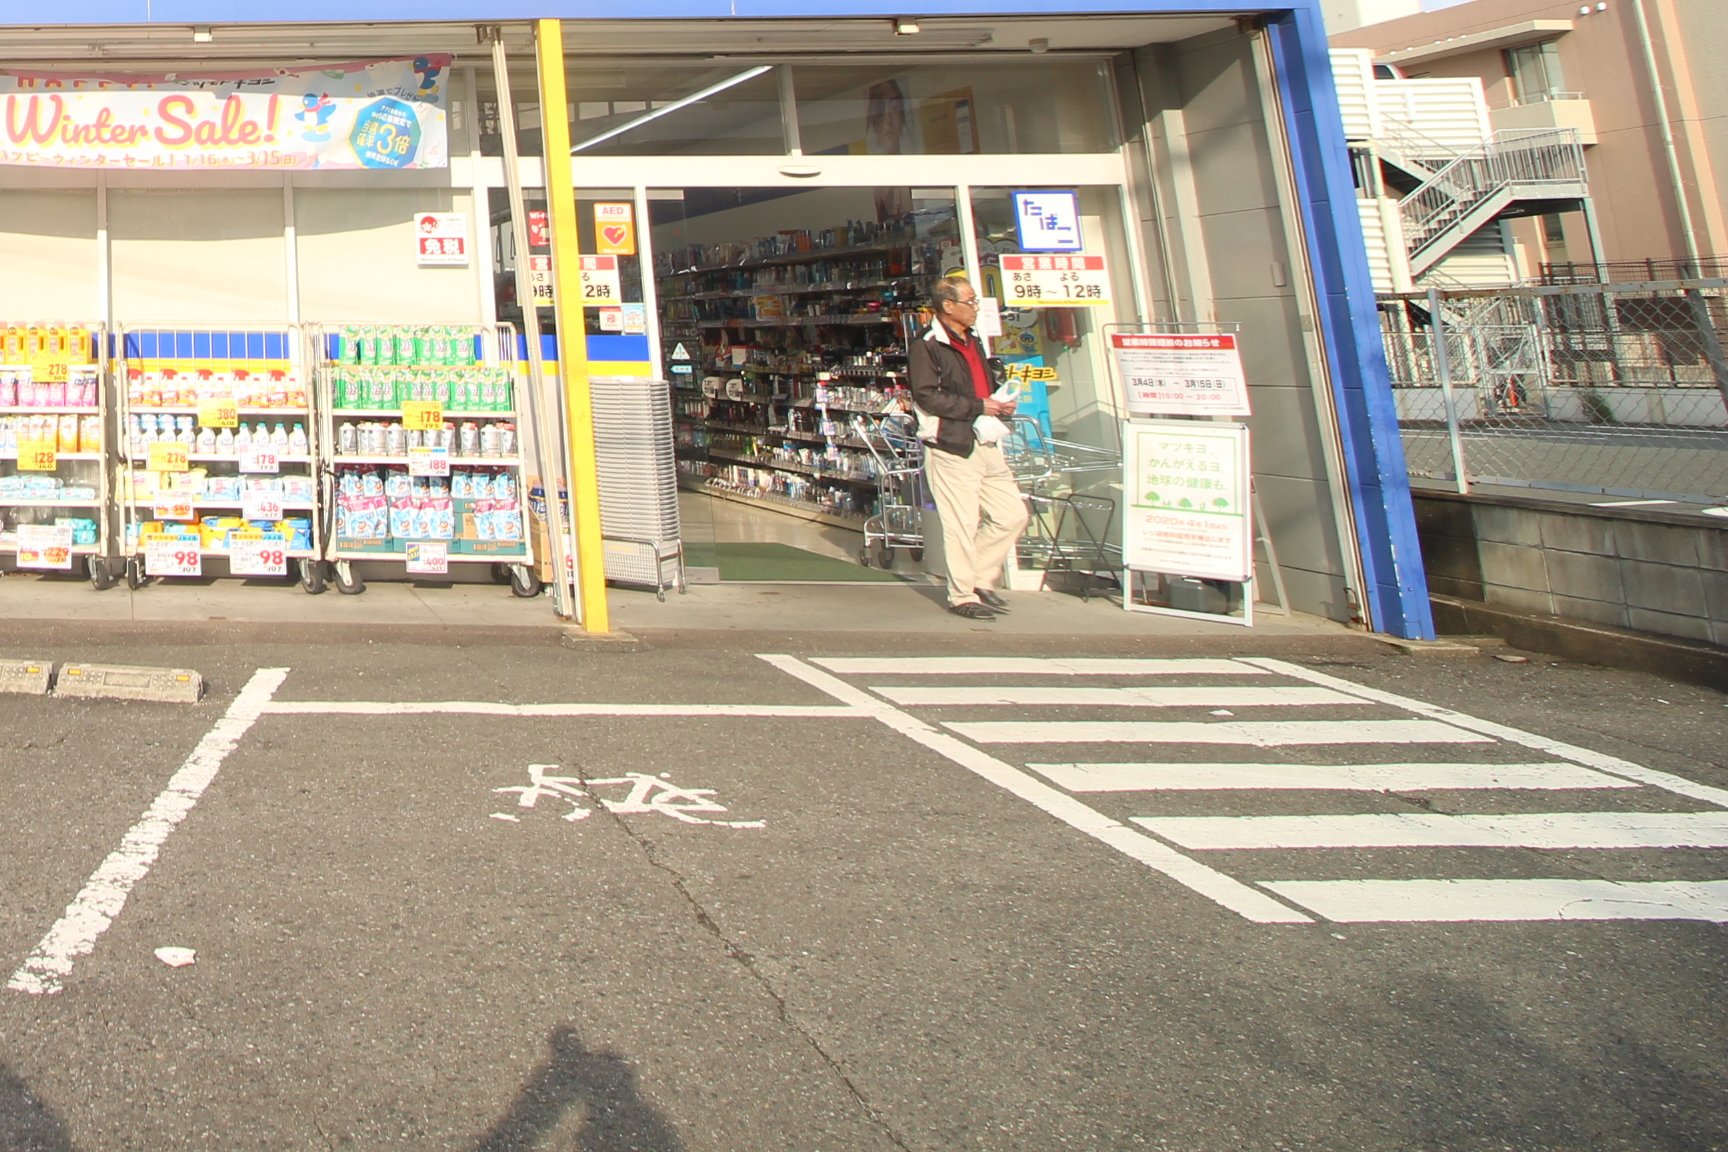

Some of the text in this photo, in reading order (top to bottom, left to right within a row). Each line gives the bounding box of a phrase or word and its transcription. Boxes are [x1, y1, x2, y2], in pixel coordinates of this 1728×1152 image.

[6, 93, 280, 146] Winter Sale!
[602, 206, 624, 215] AED
[1023, 199, 1074, 244] たばこ
[1012, 272, 1079, 282] あさ よる
[48, 363, 68, 376] 278
[216, 408, 236, 420] 380
[34, 452, 54, 463] 128
[174, 550, 199, 566] 98
[259, 549, 284, 565] 98
